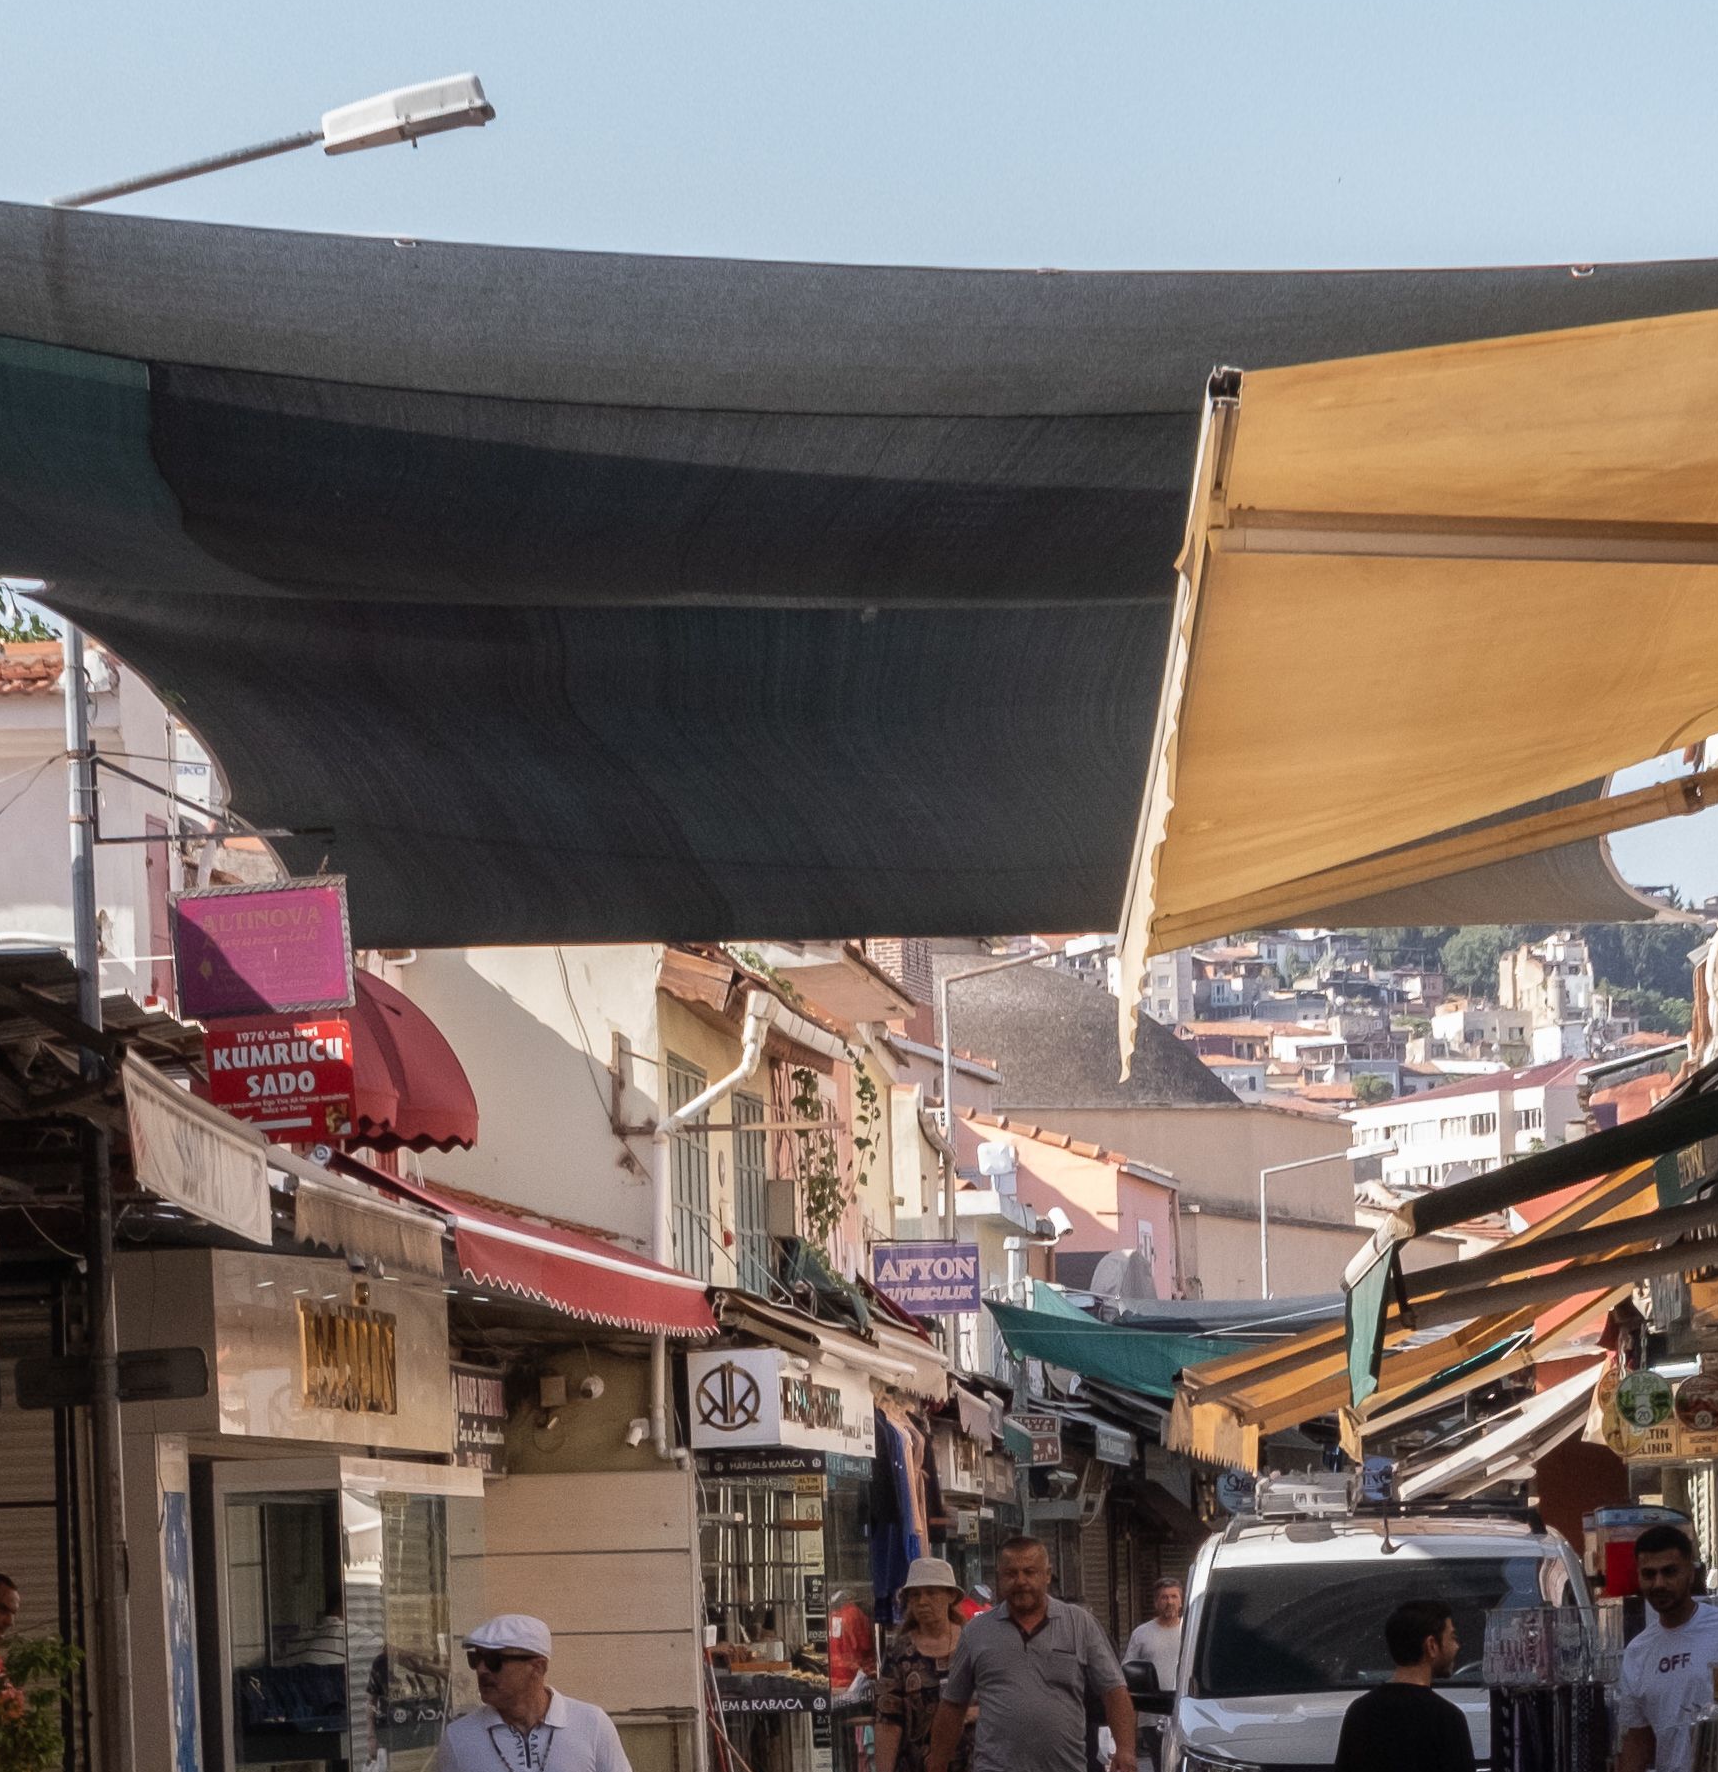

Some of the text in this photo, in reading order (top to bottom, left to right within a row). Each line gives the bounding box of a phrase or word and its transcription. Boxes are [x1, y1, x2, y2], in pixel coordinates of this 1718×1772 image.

[203, 905, 323, 933] ALTINOVA
[213, 1038, 344, 1071] KUMRUCU
[246, 1070, 316, 1098] SADO
[877, 1256, 977, 1282] AFYON
[751, 1698, 803, 1711] KARACA
